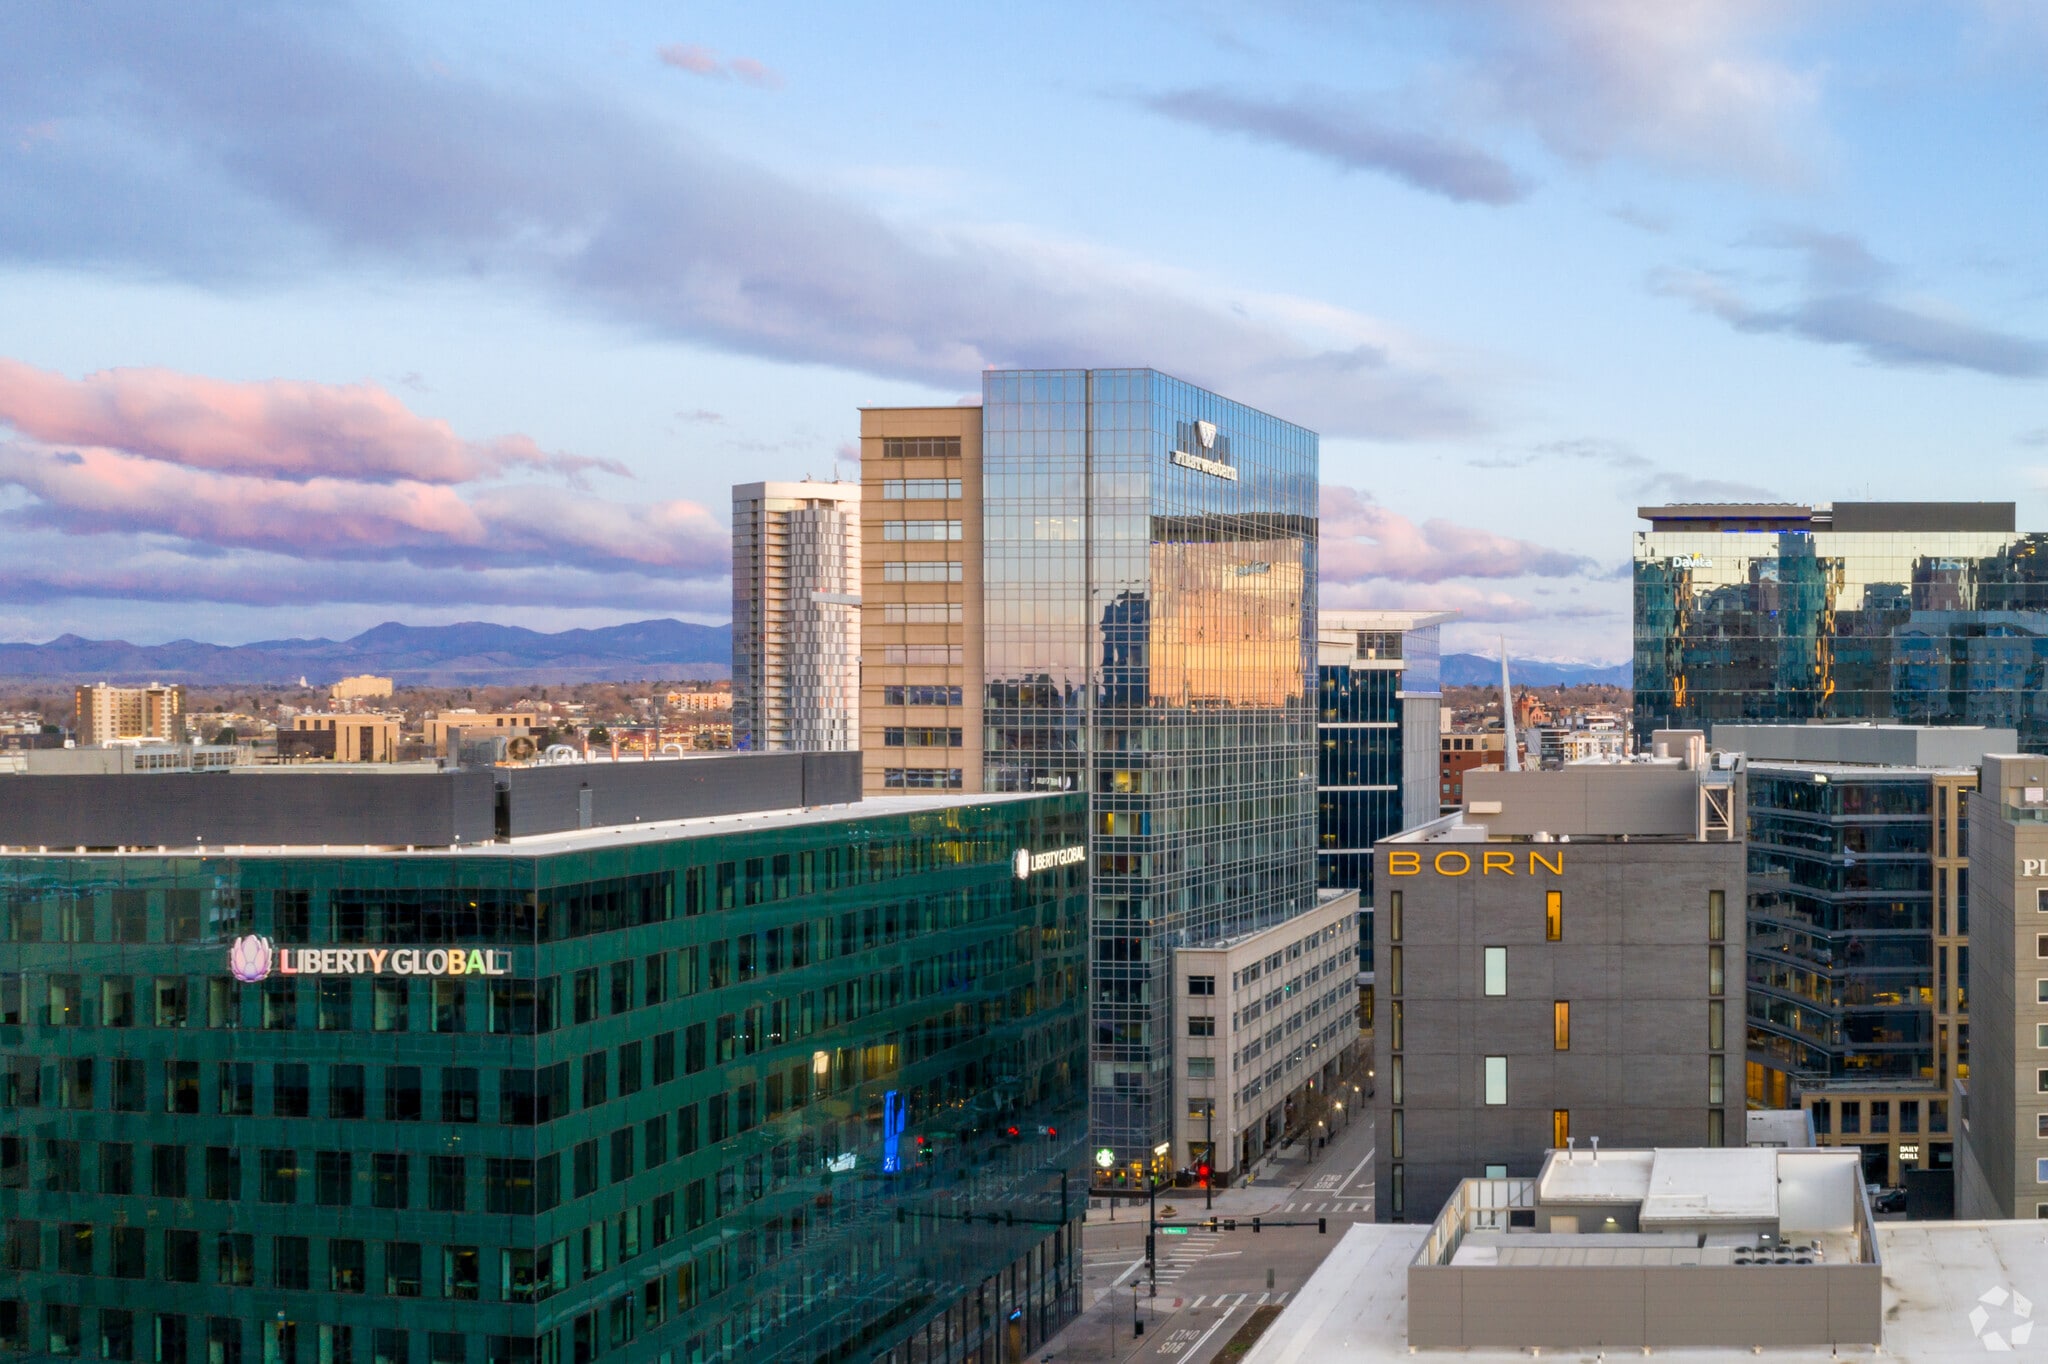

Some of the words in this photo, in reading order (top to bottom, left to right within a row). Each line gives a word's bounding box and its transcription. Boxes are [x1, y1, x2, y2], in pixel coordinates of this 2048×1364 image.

[1031, 850, 1059, 871] LIBERTY
[1059, 846, 1086, 865] GLOBAL
[1388, 851, 1563, 876] BORN
[280, 949, 388, 974] LIBERTY
[391, 949, 504, 975] GLOBAL
[1156, 1341, 1186, 1353] BUS
[1166, 1329, 1201, 1340] ONLY
